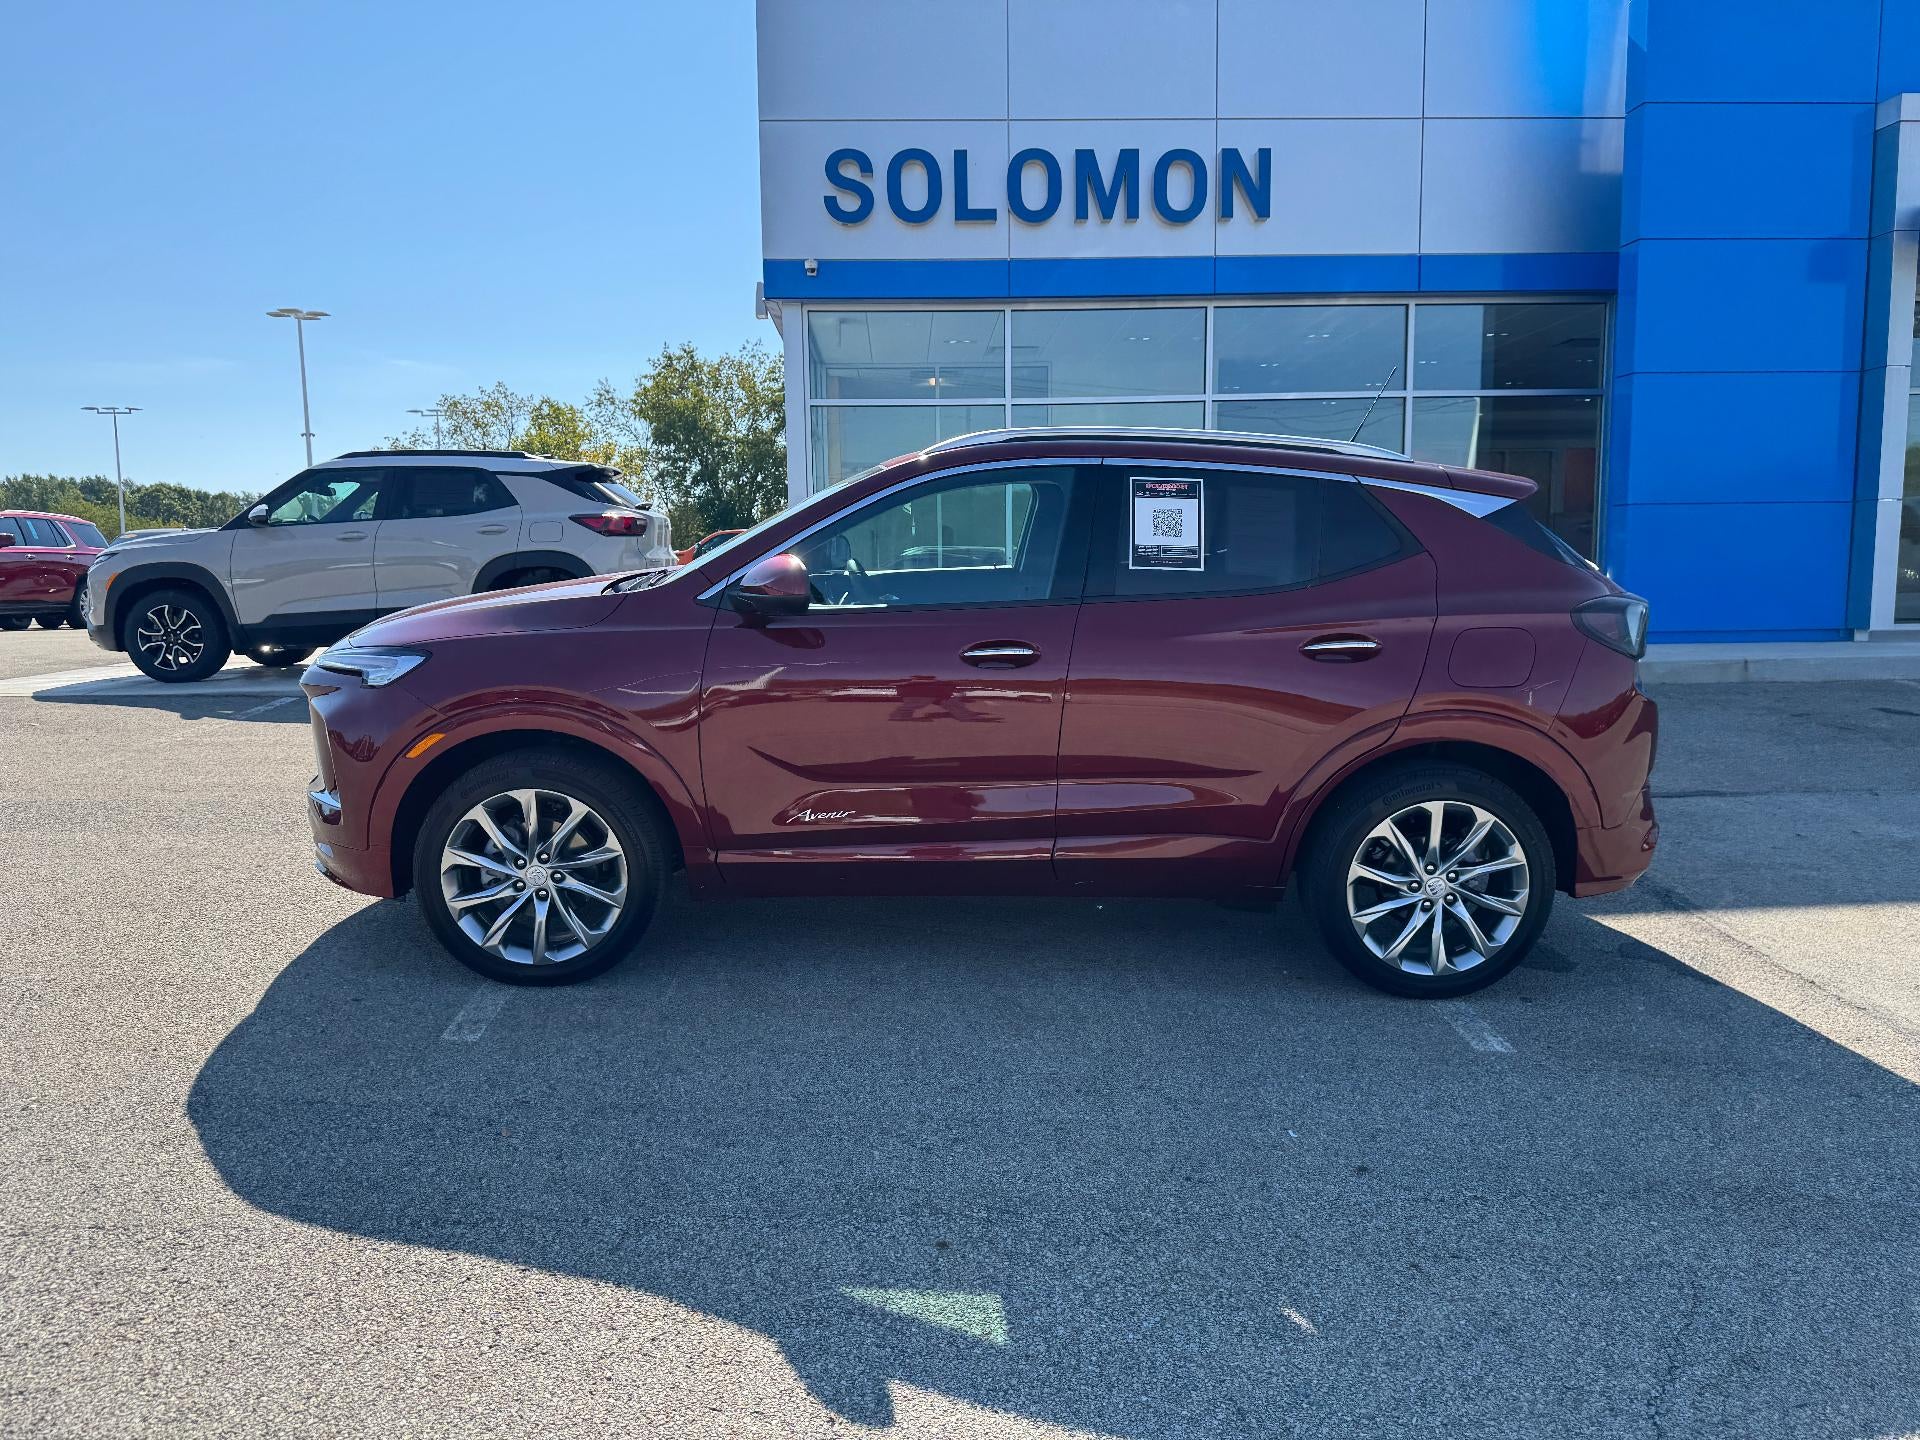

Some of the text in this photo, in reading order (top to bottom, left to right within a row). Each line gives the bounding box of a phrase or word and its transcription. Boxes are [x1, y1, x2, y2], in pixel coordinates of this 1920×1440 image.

[823, 147, 1272, 224] SOLOMON
[1382, 781, 1434, 806] Continental
[786, 808, 857, 823] Avenir
